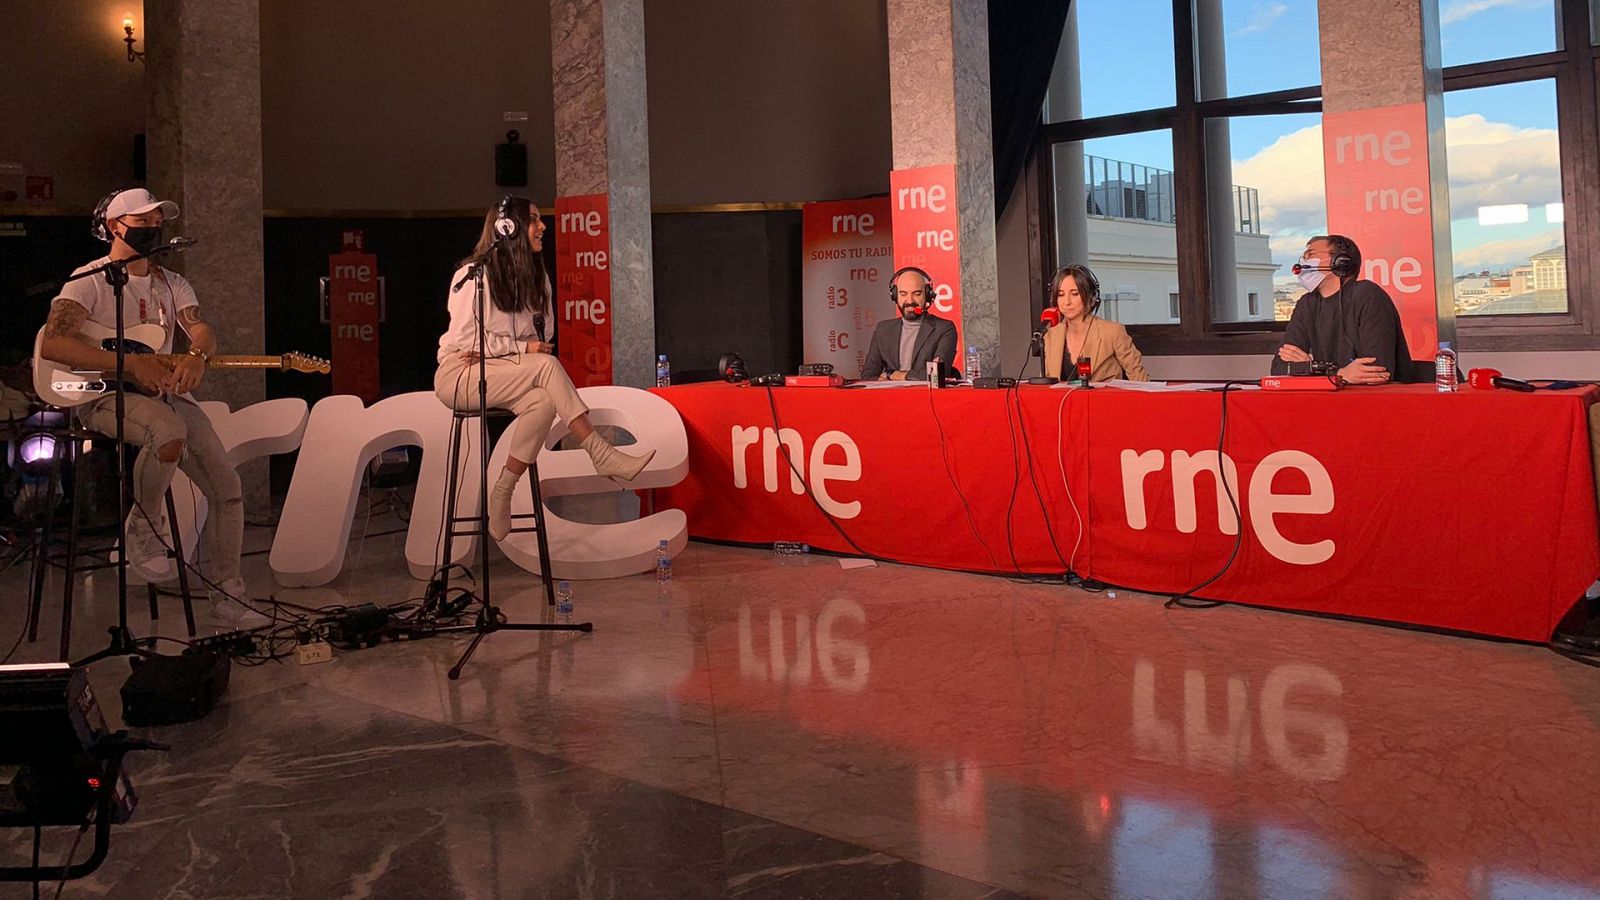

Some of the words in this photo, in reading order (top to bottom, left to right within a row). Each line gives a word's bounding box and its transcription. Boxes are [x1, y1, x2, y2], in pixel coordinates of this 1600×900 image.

[1336, 130, 1412, 166] rne
[898, 184, 946, 213] rne
[1364, 186, 1424, 214] rne
[560, 209, 601, 236] rne
[832, 213, 875, 236] rne
[917, 229, 954, 250] rne
[575, 248, 607, 270] rne
[811, 247, 847, 260] SOMOS
[849, 247, 864, 259] TU
[866, 246, 894, 258] RADI
[335, 264, 371, 282] rne
[850, 266, 878, 282] rne
[1365, 256, 1422, 294] ne
[347, 290, 375, 306] rne
[828, 286, 836, 309] radio
[837, 288, 849, 307] 3
[565, 299, 606, 325] rne
[337, 322, 374, 341] rne
[837, 332, 850, 350] C
[1264, 378, 1280, 388] rne
[731, 424, 862, 519] rne
[1120, 449, 1336, 565] rne
